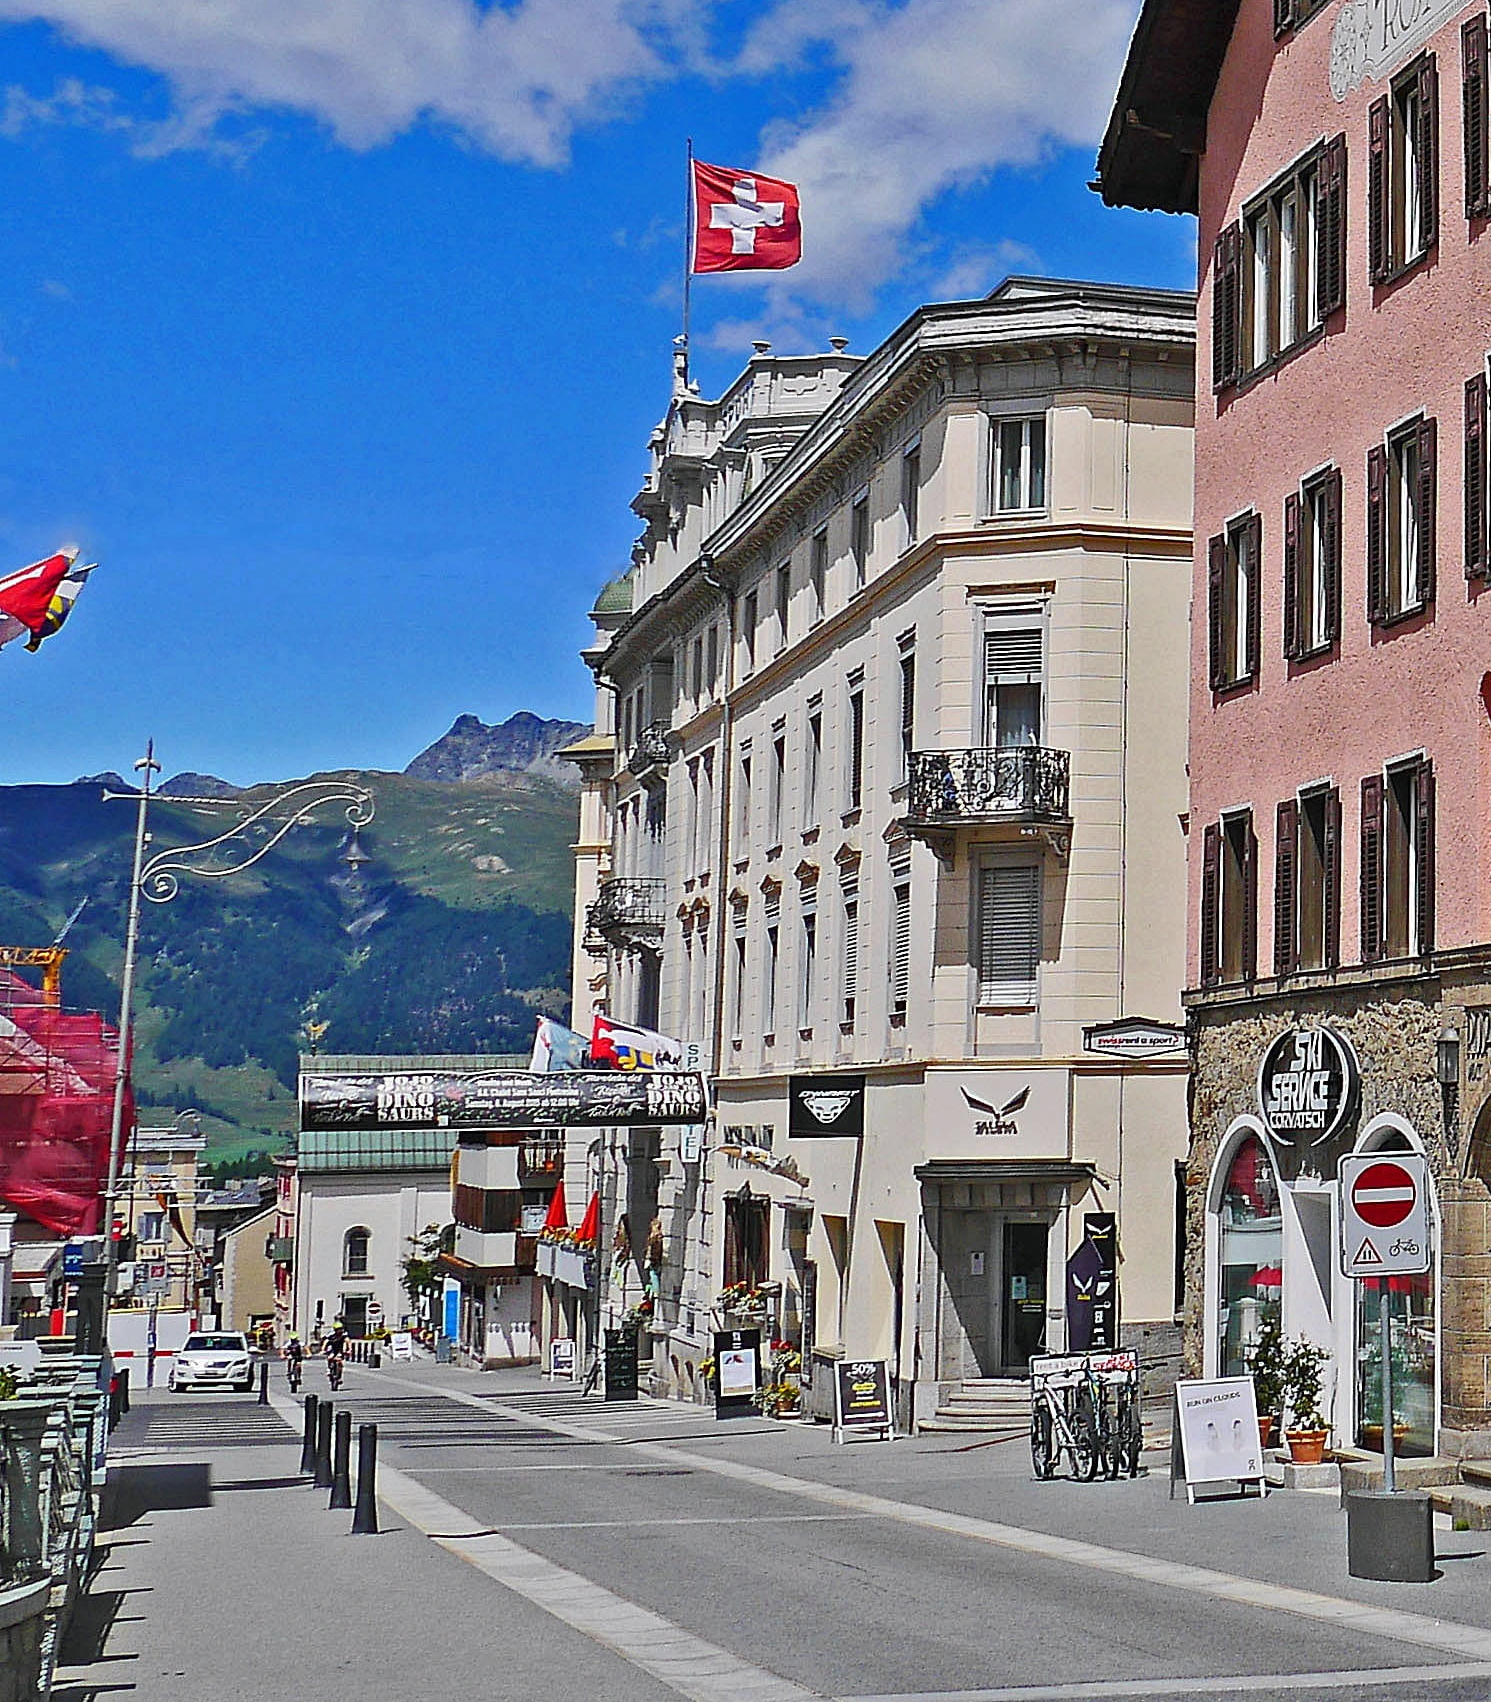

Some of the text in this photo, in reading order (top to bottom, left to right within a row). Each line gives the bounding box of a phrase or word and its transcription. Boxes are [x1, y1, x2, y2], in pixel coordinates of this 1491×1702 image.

[1290, 1031, 1323, 1071] SKI
[376, 1091, 436, 1109] DINO
[647, 1089, 700, 1104] DINO
[1267, 1070, 1330, 1112] SERVICE
[377, 1108, 435, 1122] SAURS
[1269, 1110, 1326, 1129] CORVATSCH
